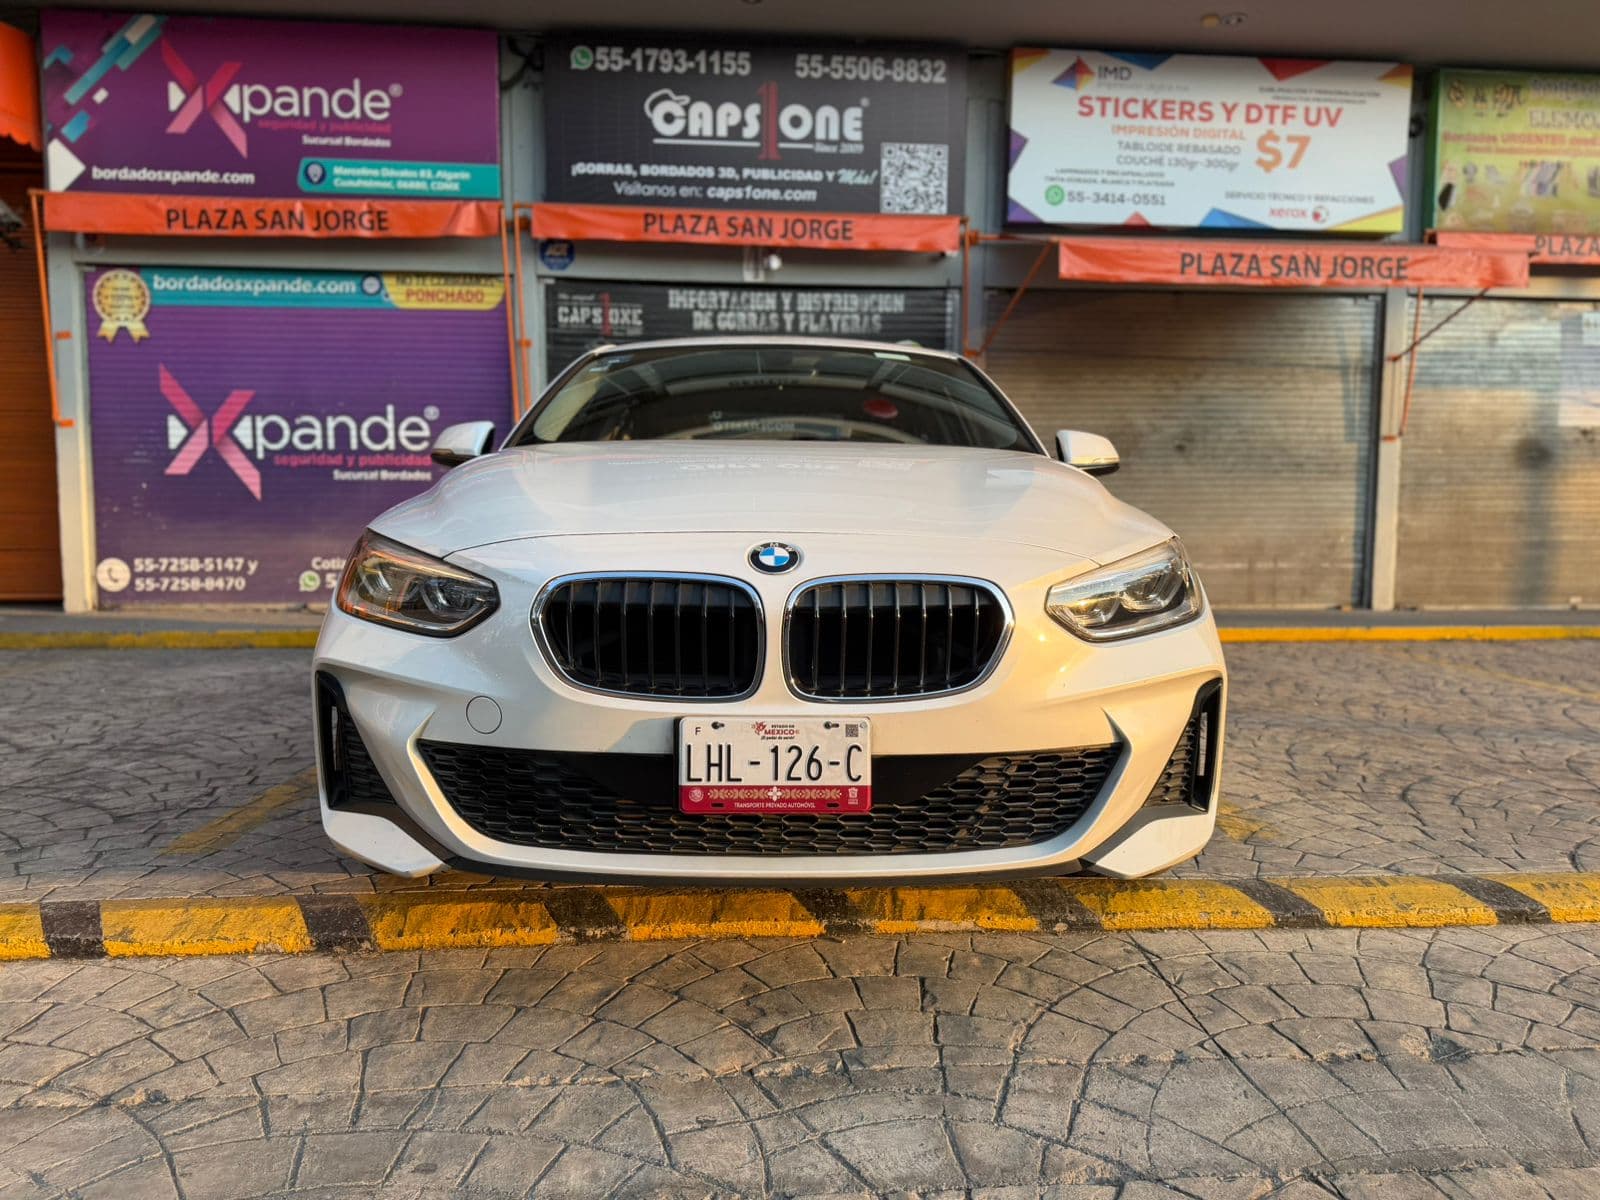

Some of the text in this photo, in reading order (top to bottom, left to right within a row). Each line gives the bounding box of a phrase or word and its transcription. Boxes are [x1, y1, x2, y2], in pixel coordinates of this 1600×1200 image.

[595, 46, 751, 76] 55-1793-1155
[795, 53, 947, 83] 55-5506-8832
[1078, 95, 1343, 128] STICKERS Y DTF UV
[1193, 128, 1246, 141] DIGITAL
[1256, 129, 1311, 174] $7
[92, 165, 256, 186] bordadosxpande.com
[640, 165, 715, 179] BORDADOS
[743, 168, 823, 182] PUBLICIDAD
[166, 208, 389, 232] PLAZA SAN JORGE
[643, 213, 854, 241] PLAZA SAN JORGE
[1535, 237, 1600, 257] PLAZA
[1180, 252, 1409, 280] PLAZA SAN JORGE
[153, 275, 357, 296] bordadosxpande.com
[692, 311, 713, 330] DE
[133, 557, 259, 575] 55-7258-5147 y
[134, 576, 246, 592] 55-7258-8470
[695, 727, 701, 735] F
[686, 743, 863, 782] LHL-126-C
